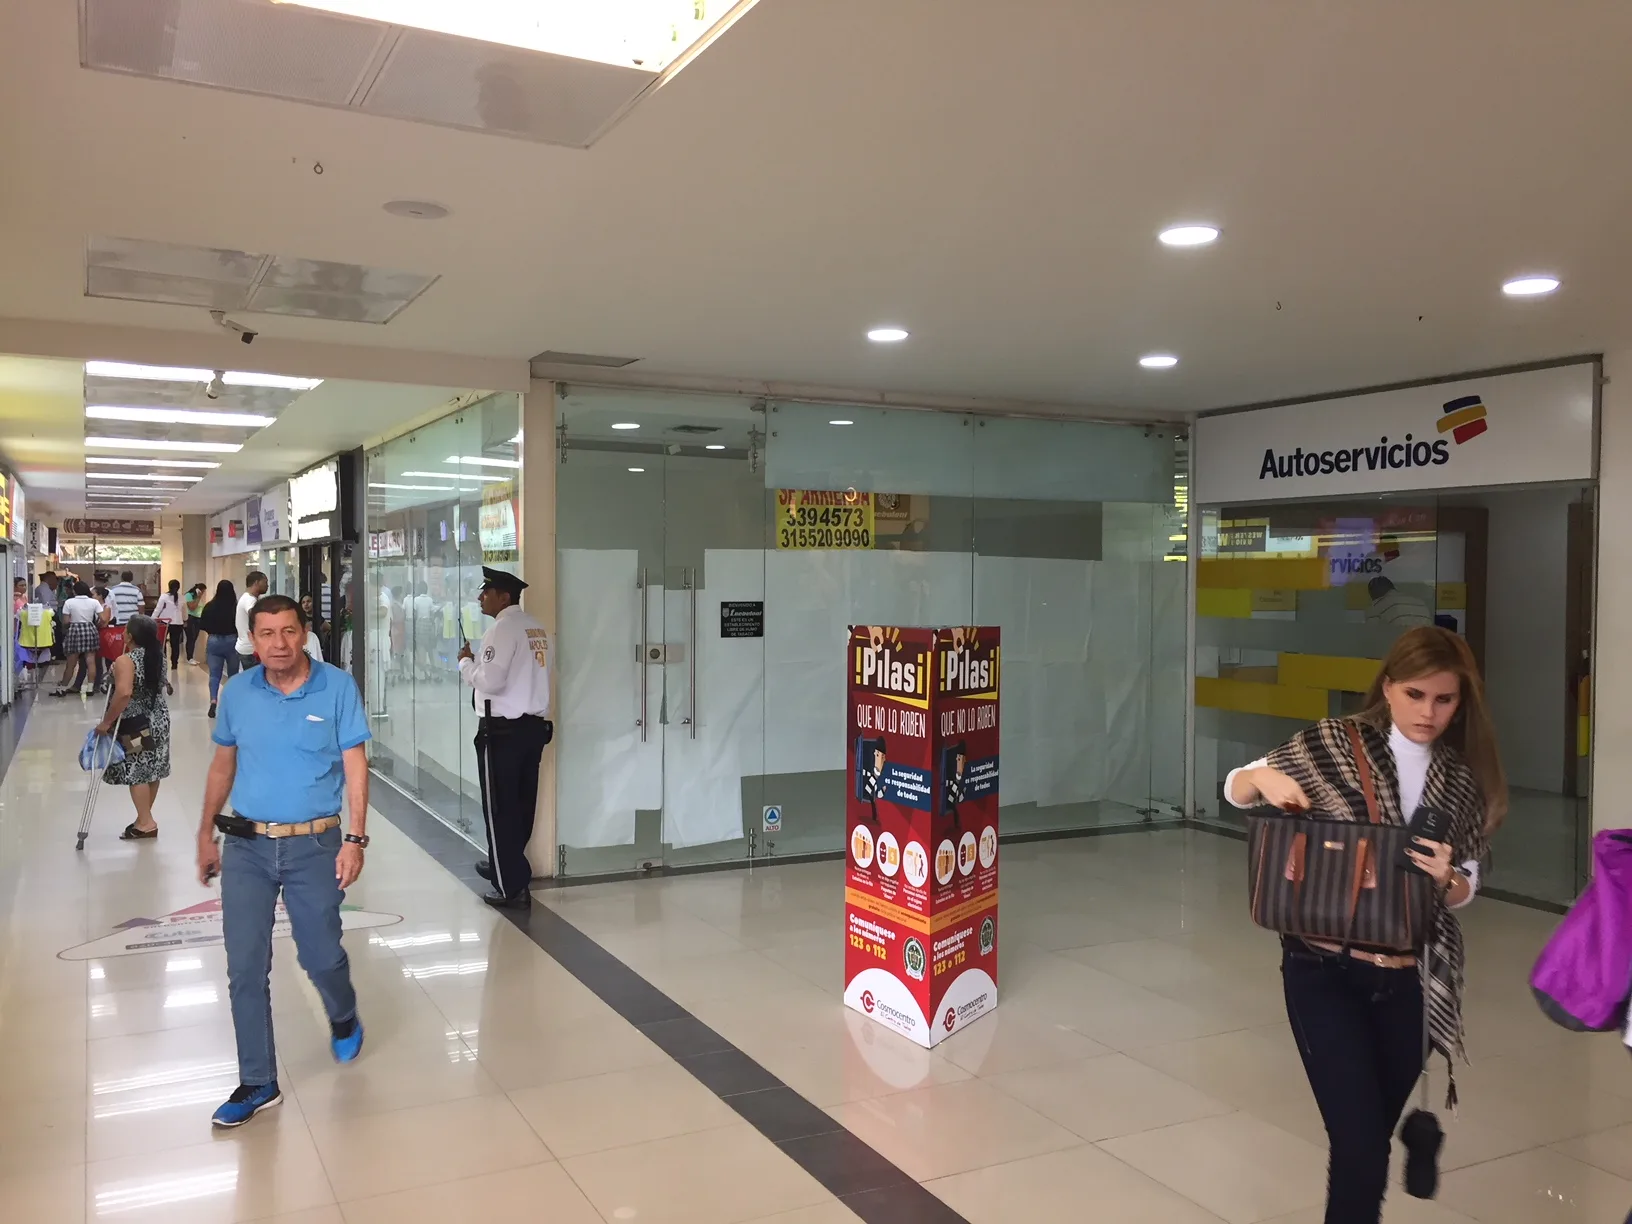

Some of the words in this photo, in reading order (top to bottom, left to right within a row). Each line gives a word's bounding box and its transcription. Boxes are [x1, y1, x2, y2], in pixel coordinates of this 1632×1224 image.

[1259, 433, 1449, 479] Autoservicios
[786, 508, 864, 527] 3394573
[781, 529, 870, 547] 3155209090
[857, 704, 872, 729] QUE
[875, 706, 886, 732] NO
[888, 708, 897, 734] LO
[900, 710, 926, 739] ROBEN
[941, 711, 955, 737] QUE
[957, 709, 966, 734] NO
[968, 707, 975, 732] LO
[977, 704, 996, 731] ROBEN
[891, 779, 931, 794] responsabilidad
[892, 768, 898, 776] La
[898, 770, 923, 782] seguridad
[904, 791, 918, 801] todos
[849, 913, 896, 941] Comuníquese
[853, 925, 861, 935] los
[862, 929, 885, 945] números
[933, 927, 973, 952] Comuníquese
[850, 934, 864, 950] 123
[873, 944, 887, 960] 112
[933, 960, 946, 976] 123
[954, 950, 965, 965] 112
[876, 1000, 916, 1027] Cosmocentro
[957, 993, 987, 1015] Cosmocentro
